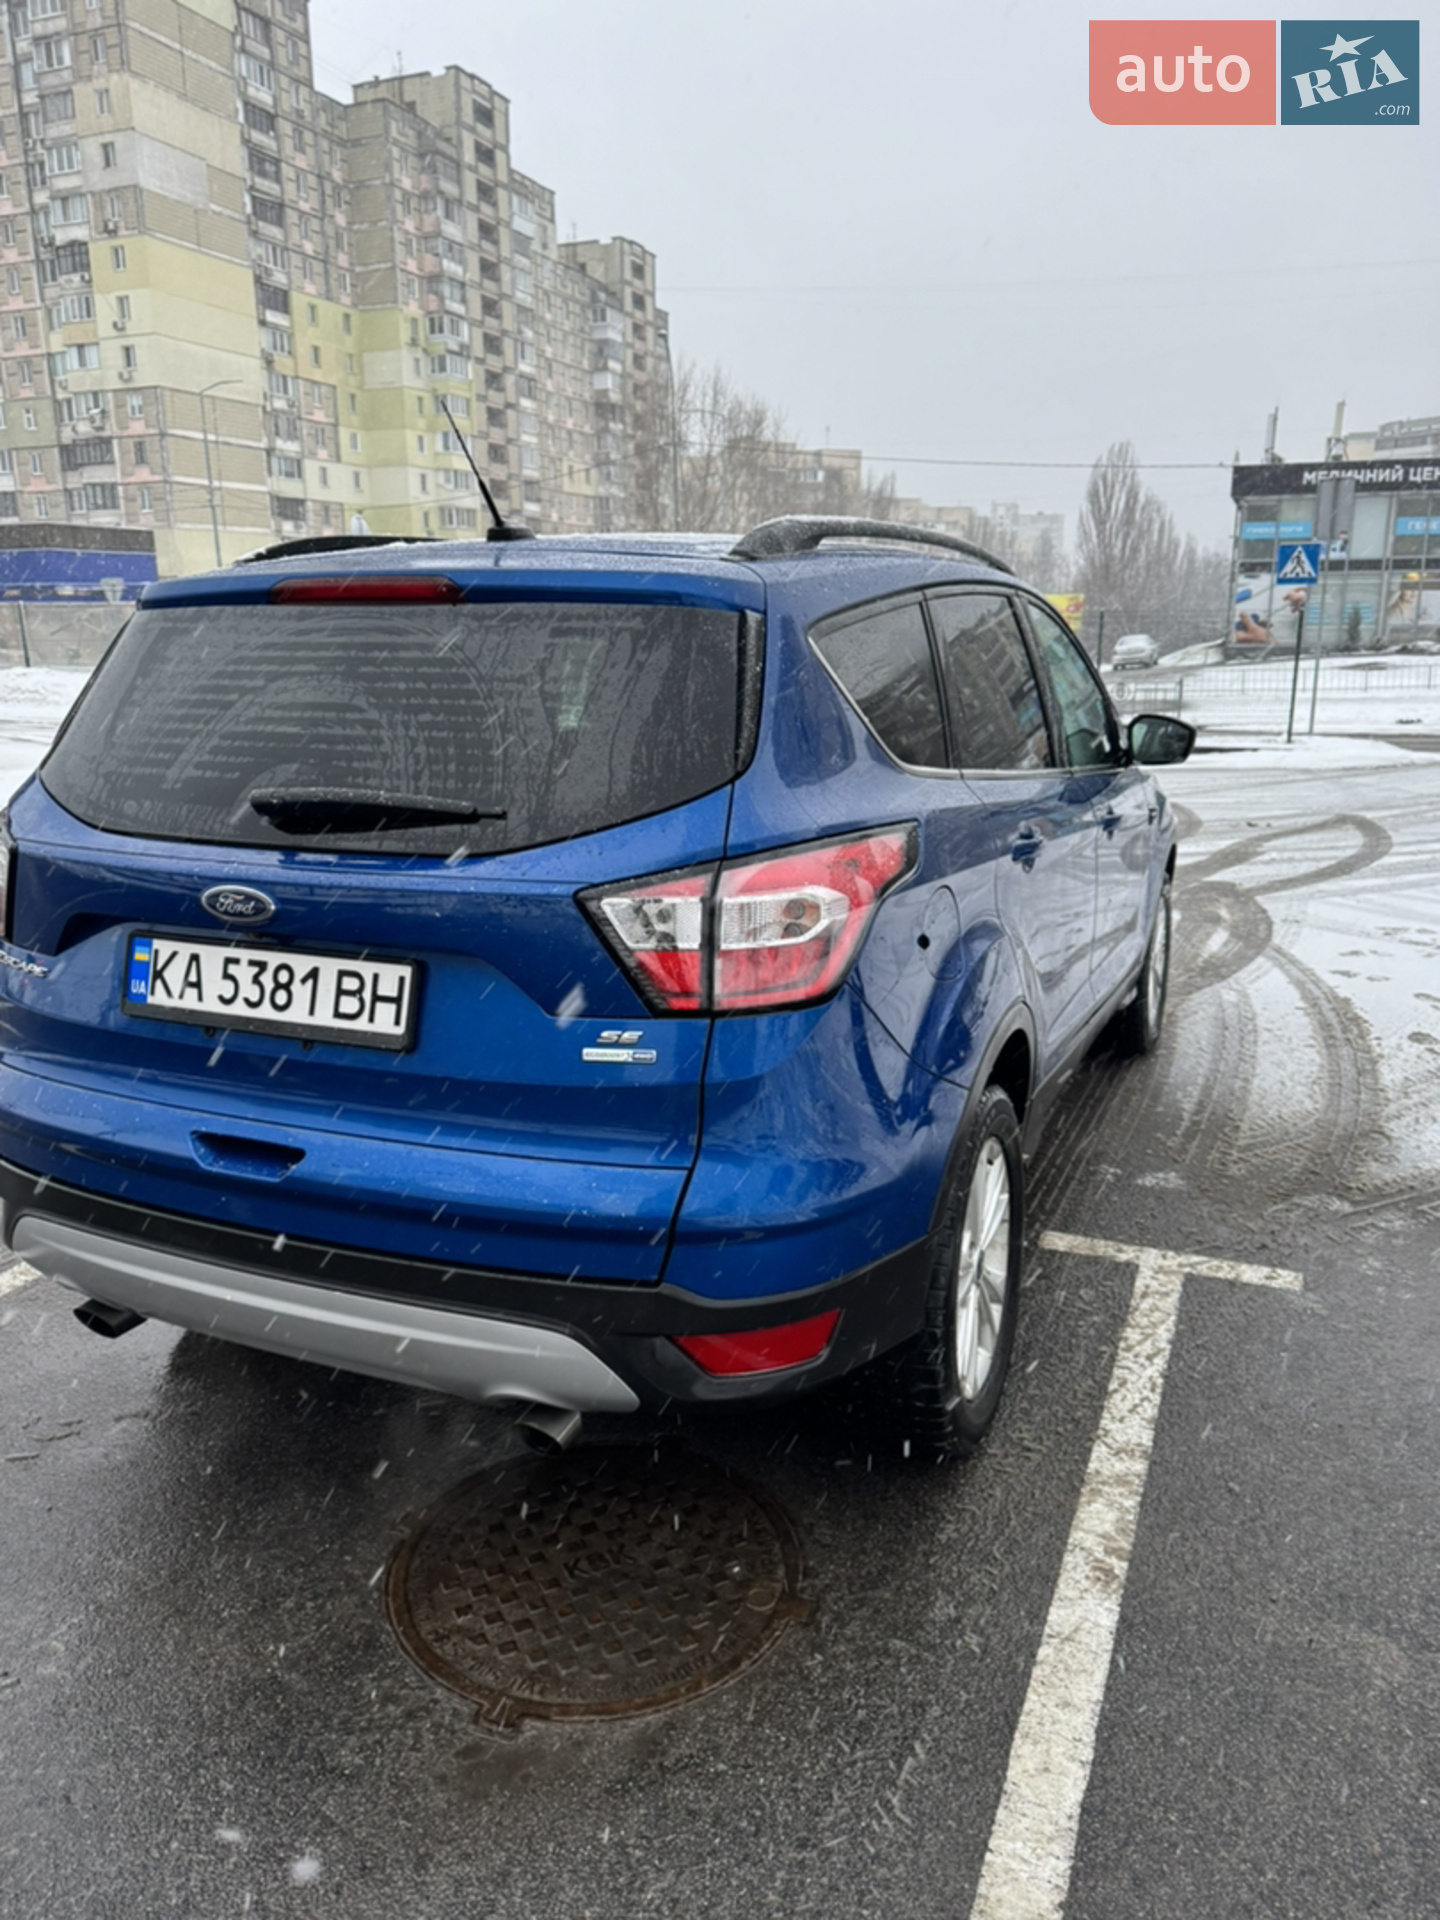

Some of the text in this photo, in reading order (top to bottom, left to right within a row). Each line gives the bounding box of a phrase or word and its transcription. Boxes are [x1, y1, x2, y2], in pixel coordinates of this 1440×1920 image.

[216, 892, 256, 915] Ford
[130, 978, 147, 995] UA
[150, 948, 406, 1027] KA 5381 BH
[596, 1030, 645, 1046] SE
